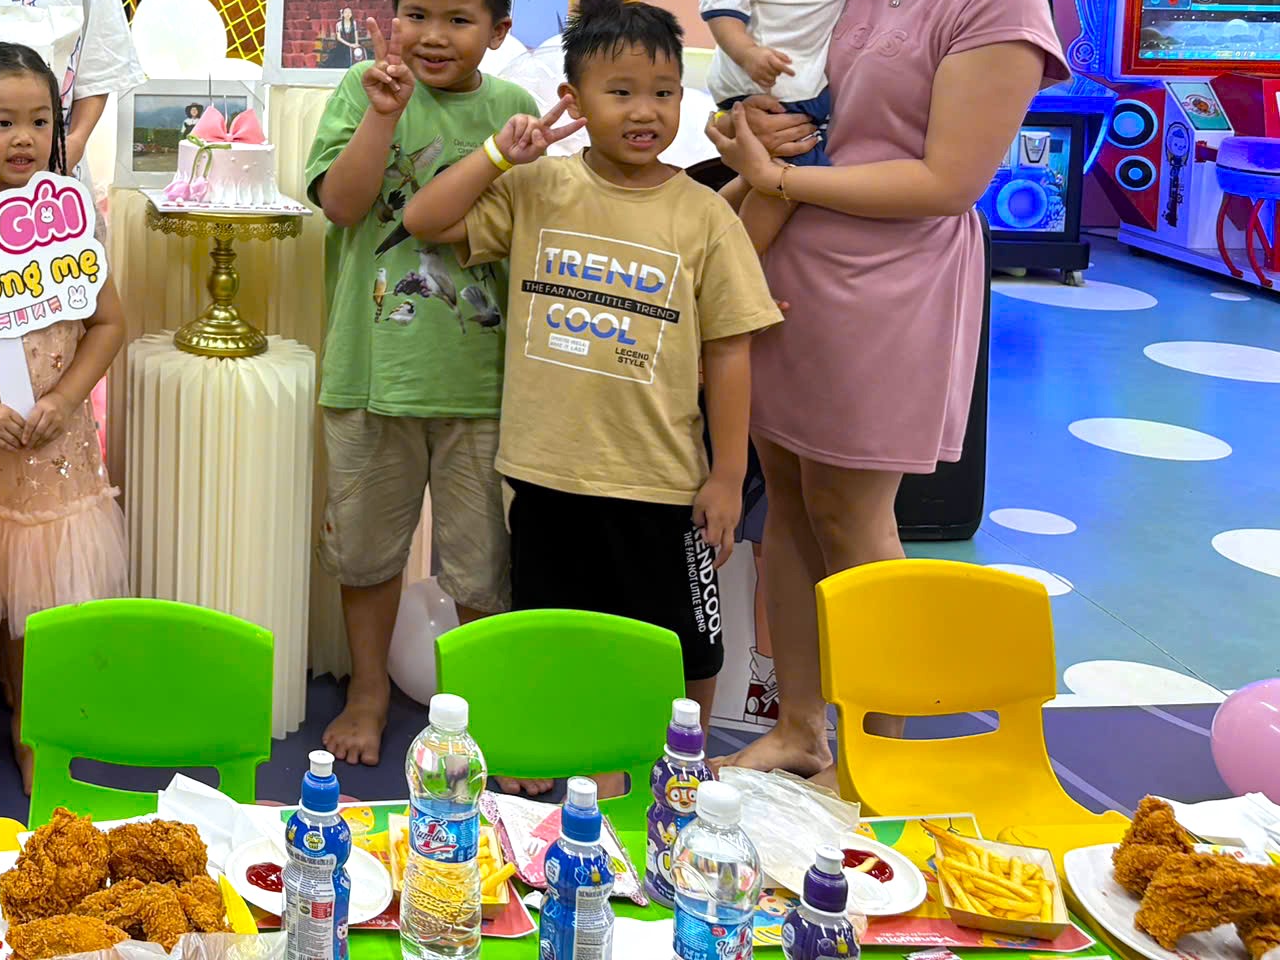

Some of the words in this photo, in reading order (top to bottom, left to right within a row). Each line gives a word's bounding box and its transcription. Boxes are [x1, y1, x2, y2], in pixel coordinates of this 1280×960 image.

[51, 249, 100, 283] mẹ
[544, 247, 666, 294] TREND
[525, 282, 544, 292] THE
[545, 285, 565, 296] FAR
[566, 289, 594, 303] NOT
[595, 294, 633, 309] LITTLE
[636, 303, 677, 320] TREND
[546, 303, 637, 345] COOL
[617, 355, 646, 369] STYLE
[683, 530, 694, 547] THE
[685, 546, 696, 564] FAR
[688, 563, 698, 584] NOT
[690, 582, 701, 606] LITTLE
[693, 605, 707, 633] TREND
[703, 583, 721, 645] COOL
